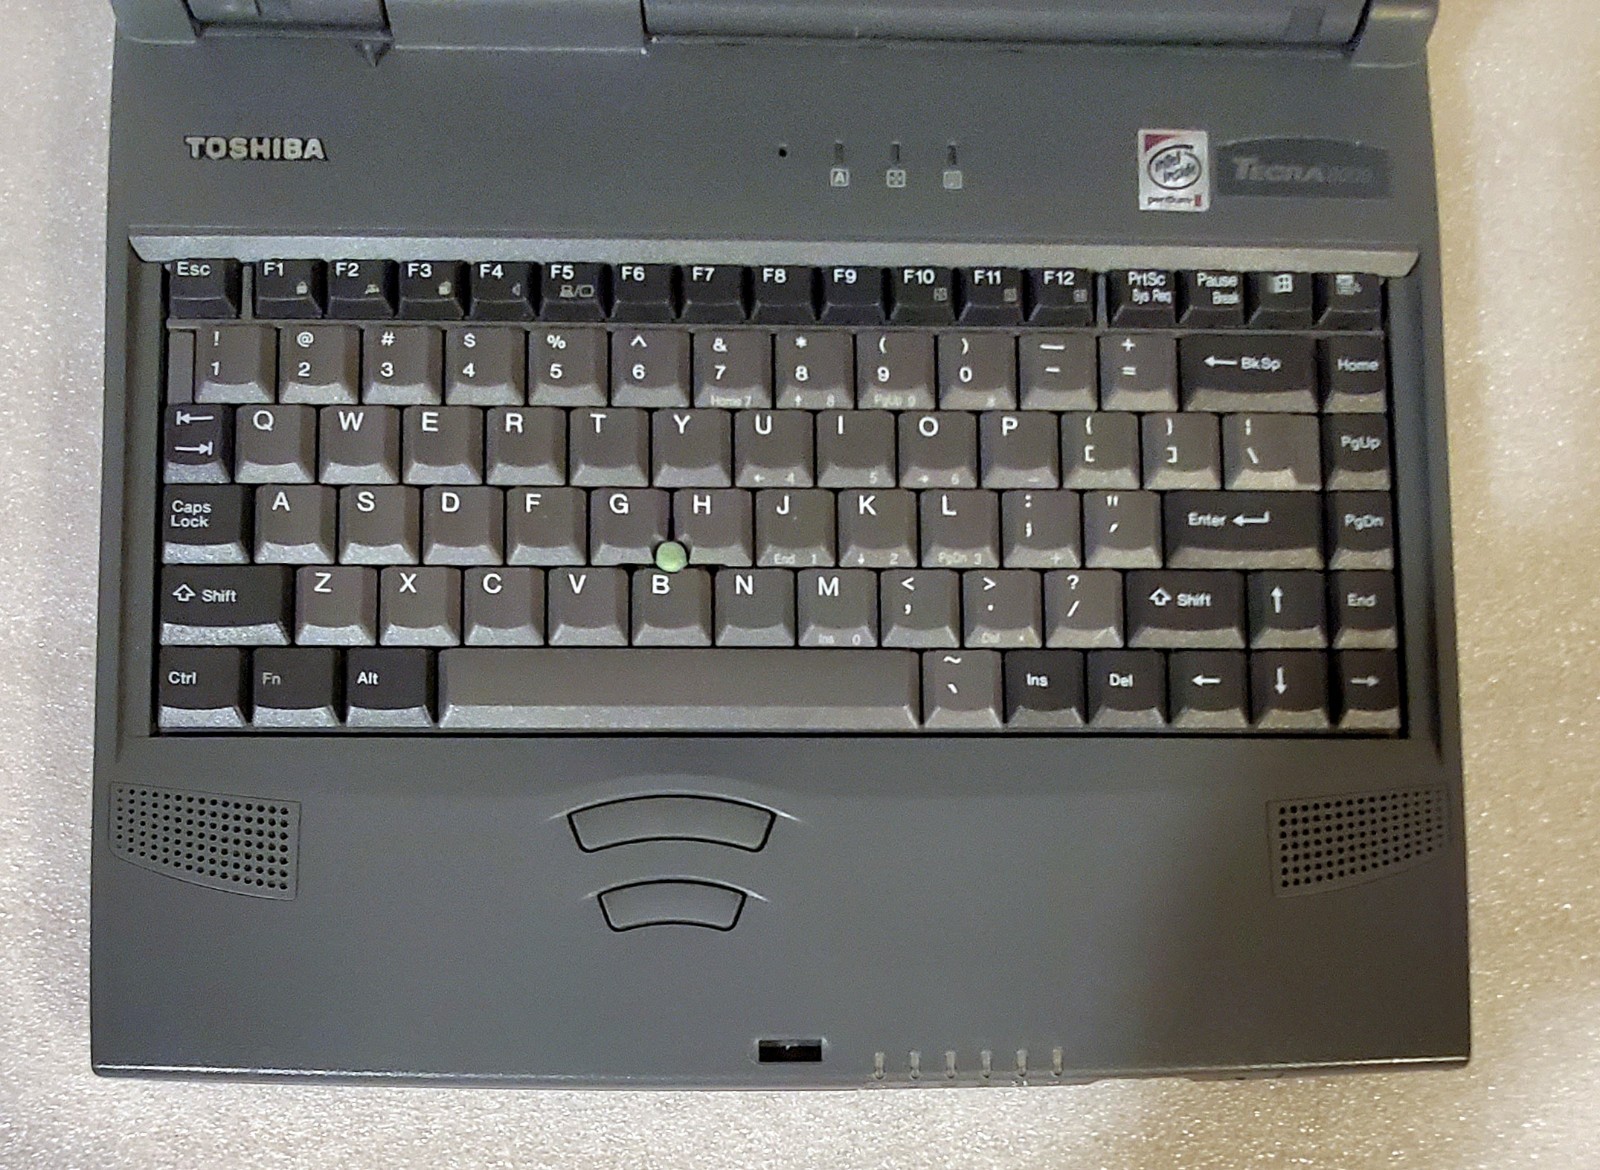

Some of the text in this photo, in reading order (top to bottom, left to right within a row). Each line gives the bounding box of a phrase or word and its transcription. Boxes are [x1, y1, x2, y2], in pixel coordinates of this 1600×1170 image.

[185, 137, 326, 160] TOSHIBA
[178, 262, 210, 276] Esc
[264, 262, 284, 276] F1
[336, 262, 358, 276] F2
[408, 262, 432, 278] F3
[480, 264, 504, 278] F4
[550, 264, 574, 280] F5
[622, 266, 644, 282] F6
[692, 266, 714, 282] F7
[764, 268, 786, 284] F8
[834, 268, 856, 284] F9
[904, 268, 934, 284] F10
[974, 270, 1000, 284] F11
[1044, 270, 1074, 286] F12
[1196, 272, 1238, 288] Pause
[214, 330, 220, 346] !
[296, 332, 314, 348] @
[380, 332, 394, 346] #
[464, 332, 476, 348] $
[546, 334, 566, 348] %
[712, 338, 728, 352] &
[880, 336, 886, 354] (
[962, 338, 968, 354] )
[1122, 338, 1136, 352] +
[212, 362, 220, 376] 1
[298, 362, 310, 376] 2
[380, 362, 394, 378] 3
[462, 362, 476, 378] 4
[550, 364, 562, 378] 5
[632, 364, 644, 380] 6
[714, 364, 726, 380] 7
[1242, 356, 1280, 372] BkSp
[1338, 358, 1378, 372] Home
[796, 366, 808, 382] 8
[878, 366, 890, 382] 9
[960, 366, 972, 382] 0
[252, 410, 274, 432] Q
[338, 410, 364, 432] W
[422, 412, 438, 432] E
[506, 412, 522, 434] R
[590, 414, 606, 434] T
[674, 414, 690, 434] Y
[756, 414, 772, 434] U
[838, 416, 844, 434] I
[918, 416, 938, 436] O
[1002, 416, 1018, 436] P
[1340, 436, 1380, 450] PgUp
[170, 500, 212, 514] Caps
[272, 492, 290, 512] A
[356, 492, 374, 512] S
[442, 492, 460, 512] D
[526, 494, 542, 512] F
[610, 494, 628, 514] G
[694, 494, 710, 514] H
[776, 496, 790, 514] J
[860, 494, 876, 516] K
[942, 496, 956, 516] L
[170, 512, 208, 528] Lock
[1188, 512, 1226, 526] Enter
[1344, 514, 1384, 530] PgDn
[314, 572, 332, 592] Z
[400, 572, 416, 592] X
[482, 574, 502, 594] C
[568, 574, 586, 594] V
[652, 574, 670, 594] B
[736, 574, 754, 594] N
[818, 576, 838, 596] M
[902, 576, 914, 590] <
[984, 578, 996, 590] >
[1066, 574, 1080, 590] ?
[202, 590, 236, 602] Shift
[1178, 594, 1210, 606] Shift
[1348, 594, 1374, 606] End
[1068, 600, 1080, 616] /
[168, 672, 196, 684] Ctrl
[262, 672, 280, 684] Fn
[358, 672, 378, 684] Alt
[1026, 674, 1048, 686] Ins
[1110, 674, 1134, 686] Del
